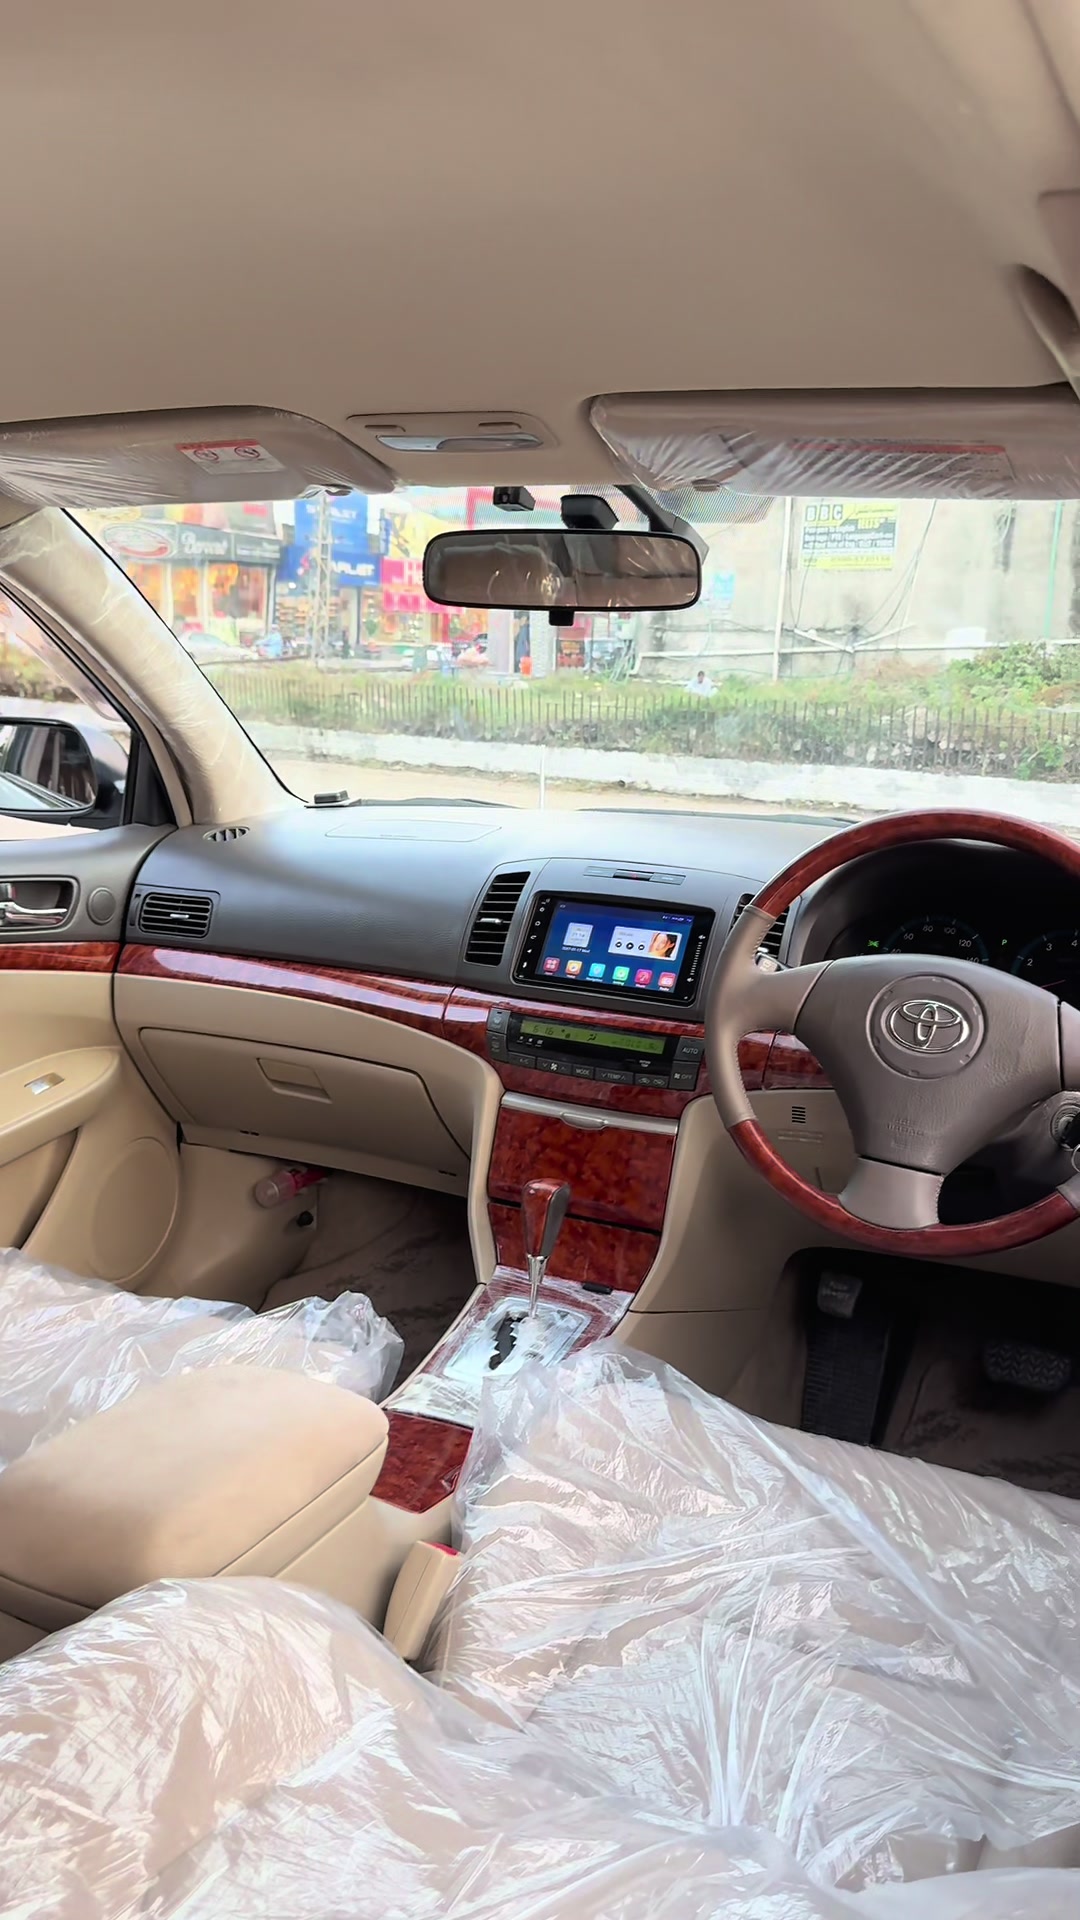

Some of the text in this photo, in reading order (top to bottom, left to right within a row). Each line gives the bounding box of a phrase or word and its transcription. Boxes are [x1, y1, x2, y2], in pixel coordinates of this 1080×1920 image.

[923, 925, 933, 933] 80
[903, 932, 972, 948] 60 120
[1045, 942, 1053, 951] 3
[1026, 958, 1034, 967] 2
[682, 1046, 699, 1055] AUTO
[575, 1067, 591, 1075] MODE
